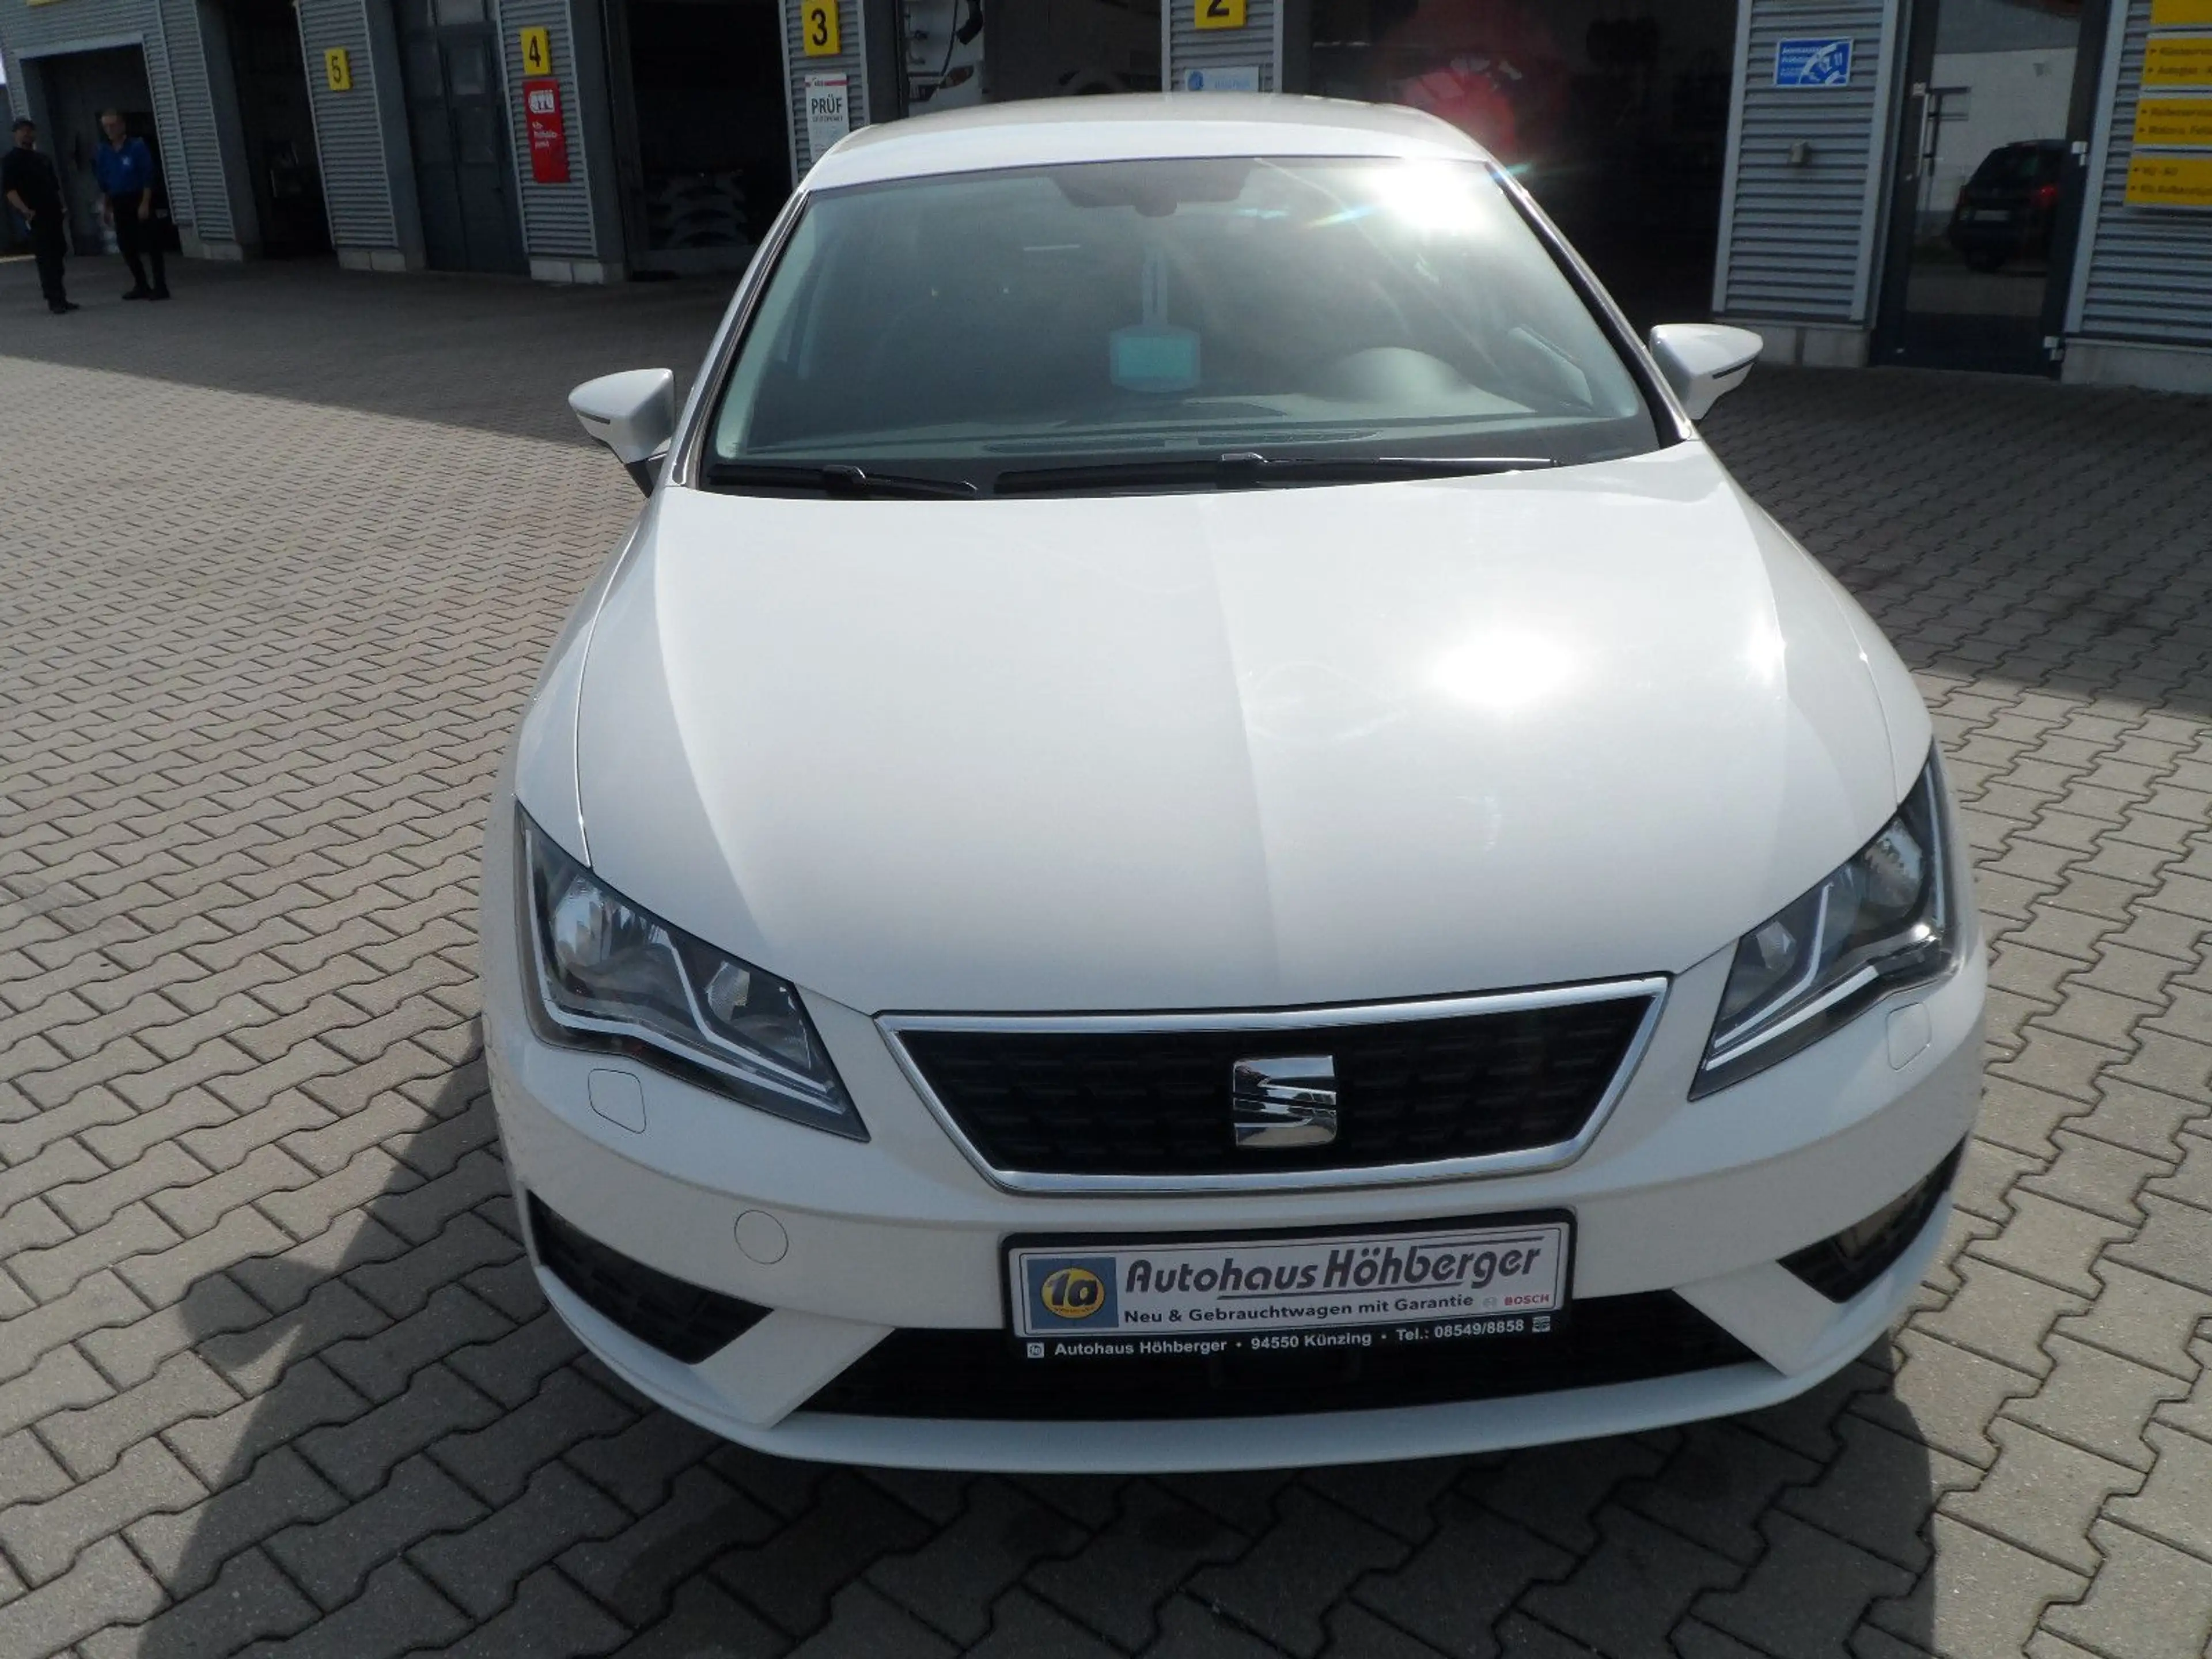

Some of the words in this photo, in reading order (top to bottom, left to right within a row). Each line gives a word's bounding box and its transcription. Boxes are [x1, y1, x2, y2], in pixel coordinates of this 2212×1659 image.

[810, 7, 828, 47] 3
[529, 35, 541, 67] 4
[332, 56, 342, 84] 5
[811, 93, 843, 115] PRÜF
[1125, 1257, 1319, 1294] Autohaus
[1323, 1246, 1542, 1289] Höhberger
[1124, 1310, 1162, 1324] Neu
[1169, 1309, 1183, 1323] &
[1189, 1305, 1353, 1322] Gebrauchtwagen
[1358, 1300, 1389, 1313] mit
[1394, 1294, 1475, 1312] Garantie
[1504, 1294, 1550, 1307] BOSCH
[1054, 1342, 1134, 1357] Autohaus
[1139, 1340, 1228, 1355] Höhberger
[1251, 1336, 1300, 1350] 94550
[1304, 1332, 1372, 1348] Künzing
[1396, 1328, 1430, 1342] Tel.:
[1434, 1318, 1525, 1340] 08549/8858
